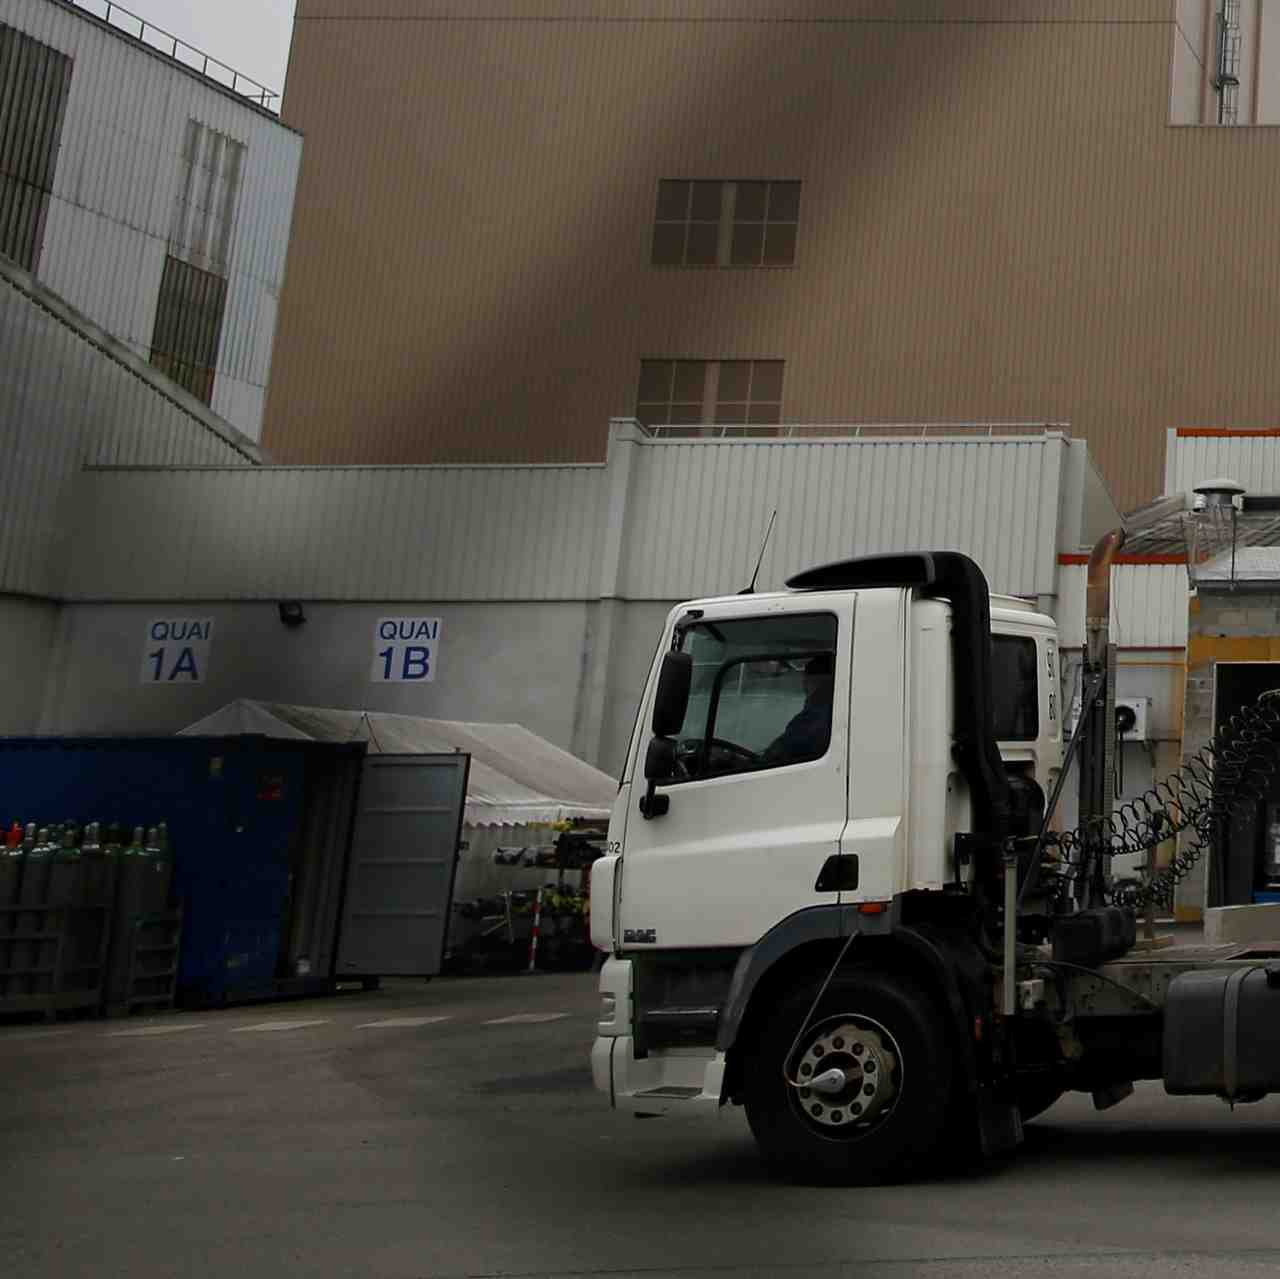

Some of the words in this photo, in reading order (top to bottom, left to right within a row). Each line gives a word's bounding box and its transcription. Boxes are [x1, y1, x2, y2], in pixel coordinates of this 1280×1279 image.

[151, 621, 211, 640] QUAI
[379, 621, 438, 640] QUAI
[149, 646, 199, 681] 1A
[379, 646, 430, 680] 1B
